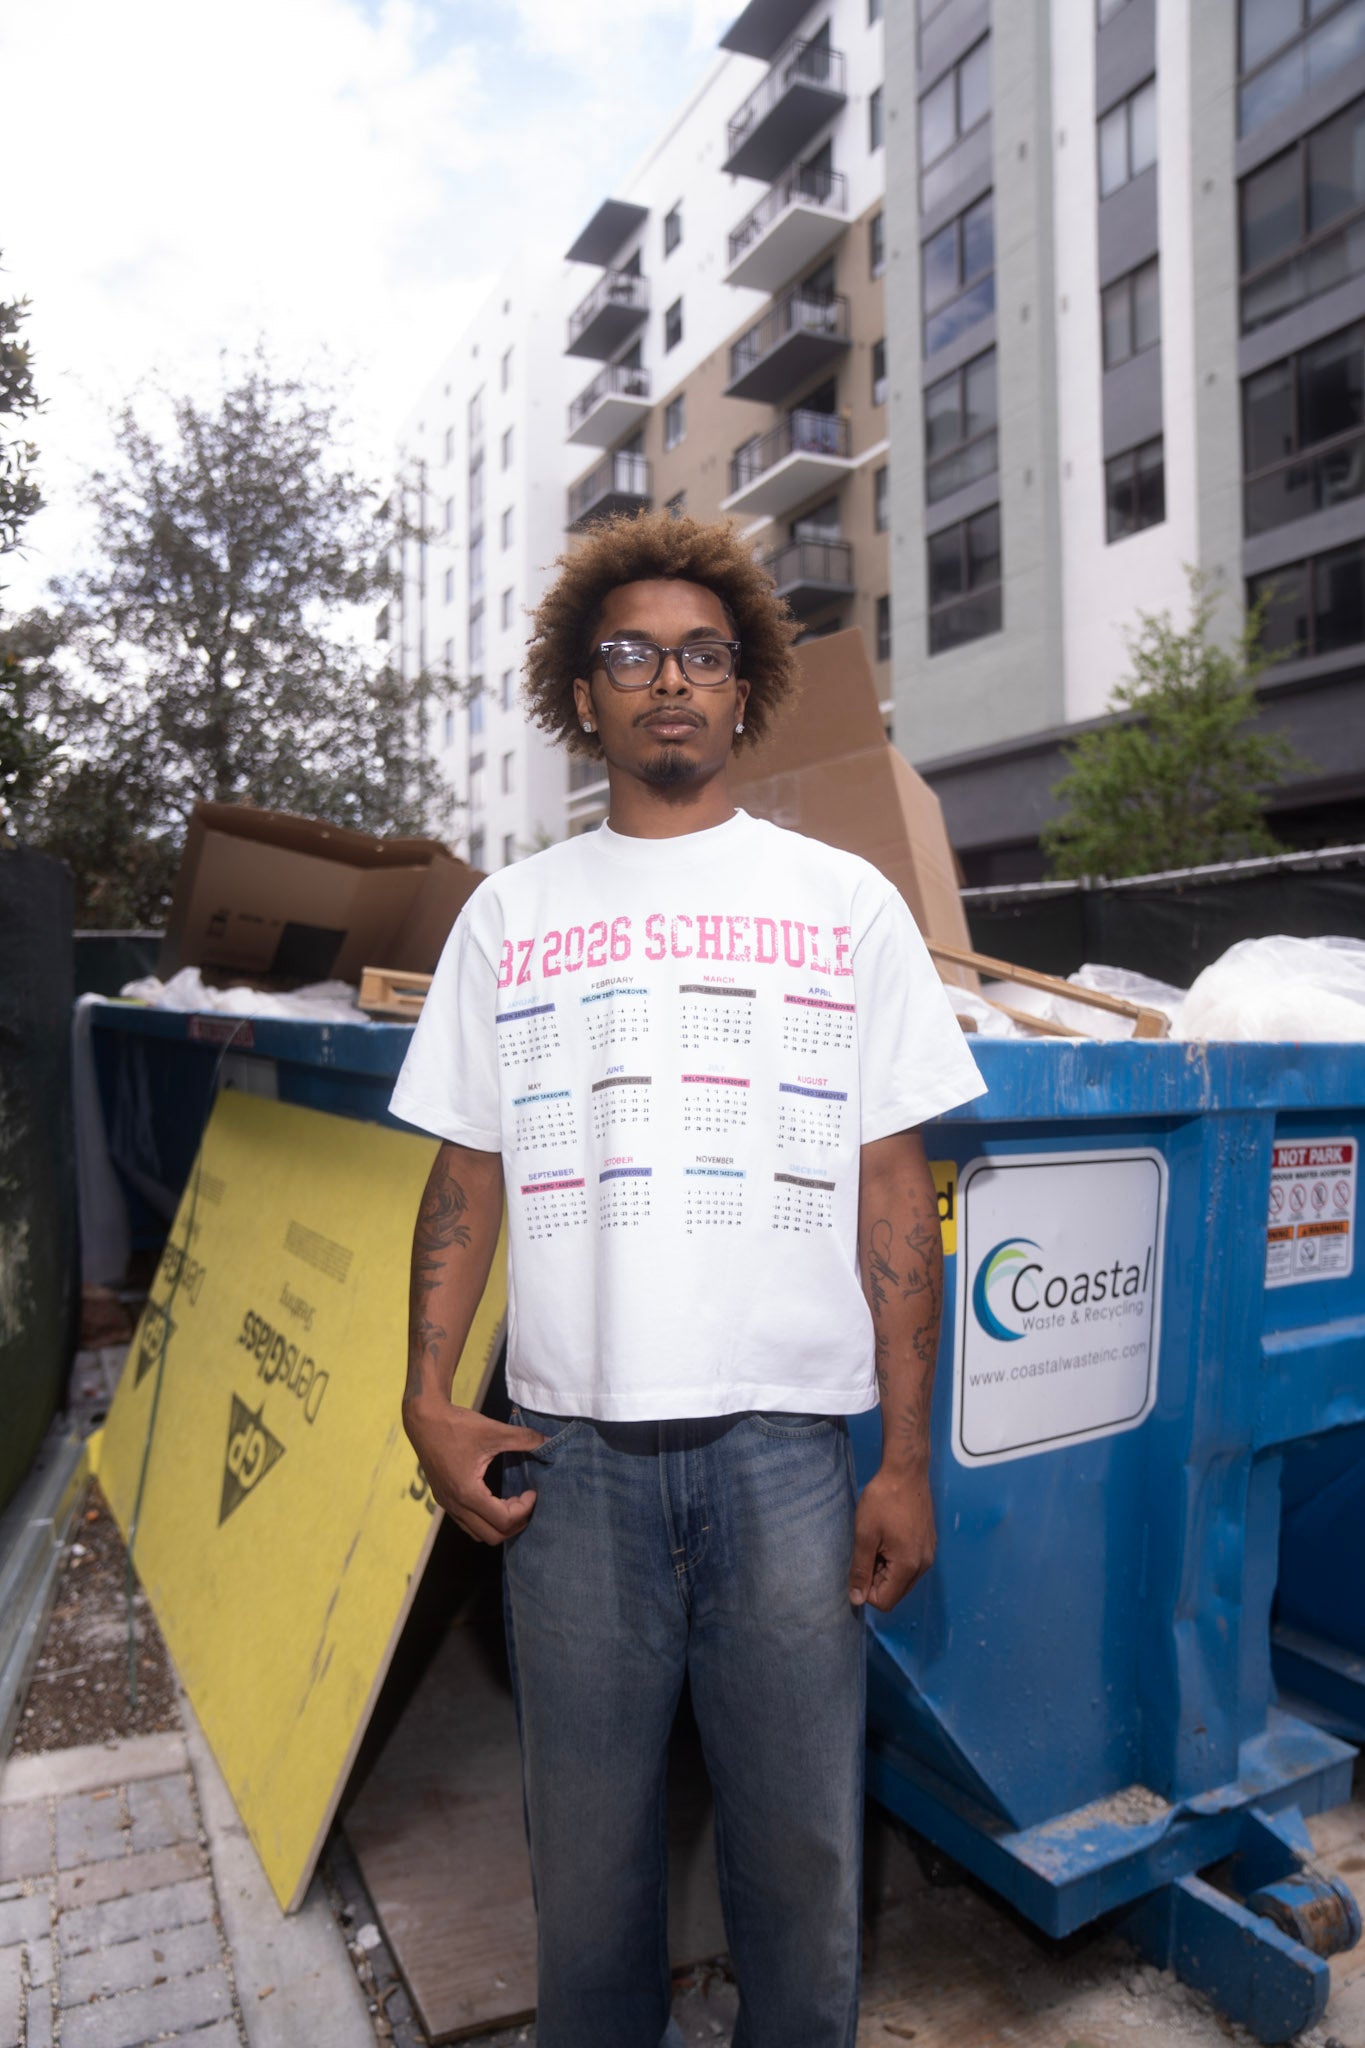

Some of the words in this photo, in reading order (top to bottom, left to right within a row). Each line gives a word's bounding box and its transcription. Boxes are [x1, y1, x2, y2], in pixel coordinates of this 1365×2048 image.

[542, 915, 632, 979] 2026
[644, 913, 855, 976] SCHEDULE
[591, 976, 635, 989] FEBRUARY
[703, 975, 735, 984] MARCH
[582, 995, 601, 1003] BELOW
[602, 990, 615, 998] ZERO
[808, 987, 832, 998] APRIL
[507, 995, 541, 1008] JANUARY
[786, 996, 806, 1004] BELOW
[824, 1001, 855, 1011] TAKEOVER
[606, 1064, 625, 1075] JUNE
[528, 1082, 542, 1090] MAY
[720, 1078, 746, 1086] TAKEOVER
[797, 1075, 828, 1086] AUGUST
[696, 1156, 734, 1164] NOVEMBER
[1278, 1148, 1306, 1166] NOT
[1309, 1146, 1344, 1164] PARK
[528, 1168, 575, 1181] SEPTEMBER
[1012, 1246, 1152, 1313] Coastal
[1022, 1312, 1066, 1332] Waste
[1070, 1310, 1080, 1326] &
[1084, 1299, 1144, 1325] Recycling
[235, 1308, 330, 1426] DensGlass
[970, 1342, 1147, 1388] www.coastalwasteinc.com
[227, 1421, 269, 1490] GP
